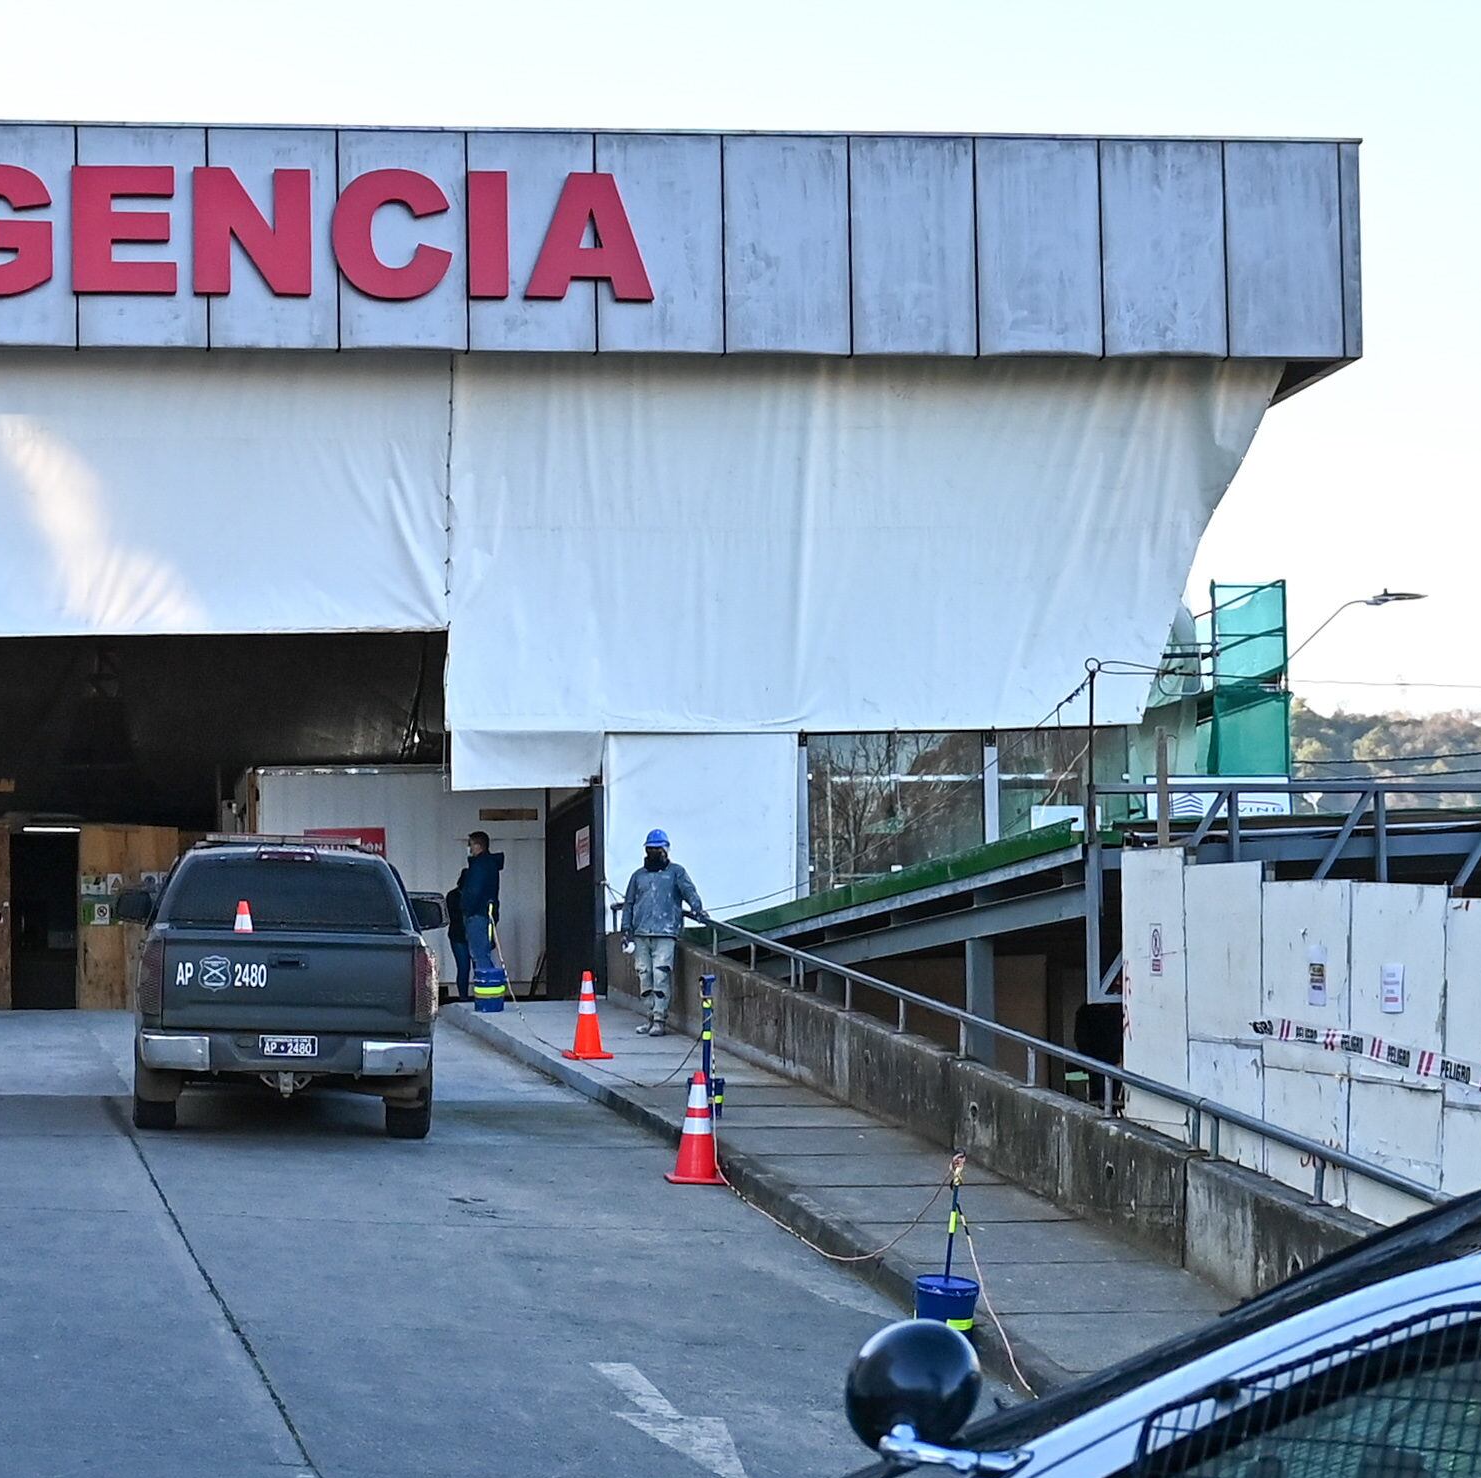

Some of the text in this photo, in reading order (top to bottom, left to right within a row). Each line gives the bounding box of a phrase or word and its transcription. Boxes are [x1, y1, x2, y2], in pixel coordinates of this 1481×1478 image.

[175, 962, 267, 988] AP 2480
[264, 1042, 312, 1054] AP 2480
[1440, 1059, 1471, 1084] PELIGRO
